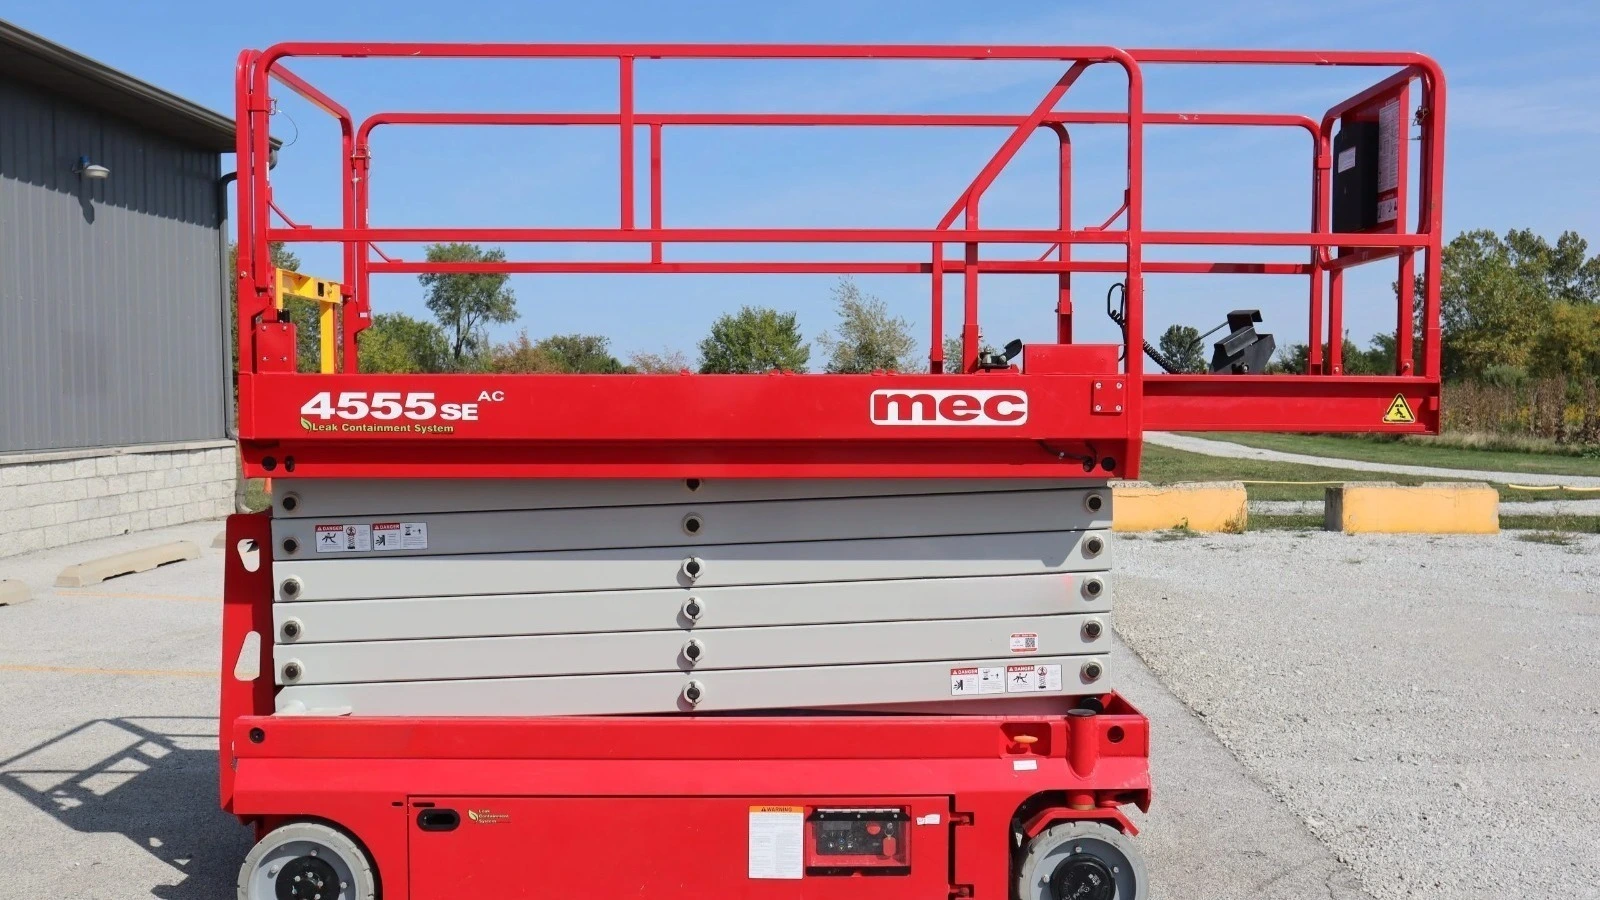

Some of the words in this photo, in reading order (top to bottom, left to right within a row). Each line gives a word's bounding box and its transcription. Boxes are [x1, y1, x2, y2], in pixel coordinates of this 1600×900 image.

[301, 391, 437, 420] 4555
[440, 403, 479, 420] SE
[477, 390, 505, 402] AC
[873, 394, 1026, 421] mec
[312, 423, 338, 431] Leak
[341, 423, 411, 432] Containment
[414, 424, 454, 434] System
